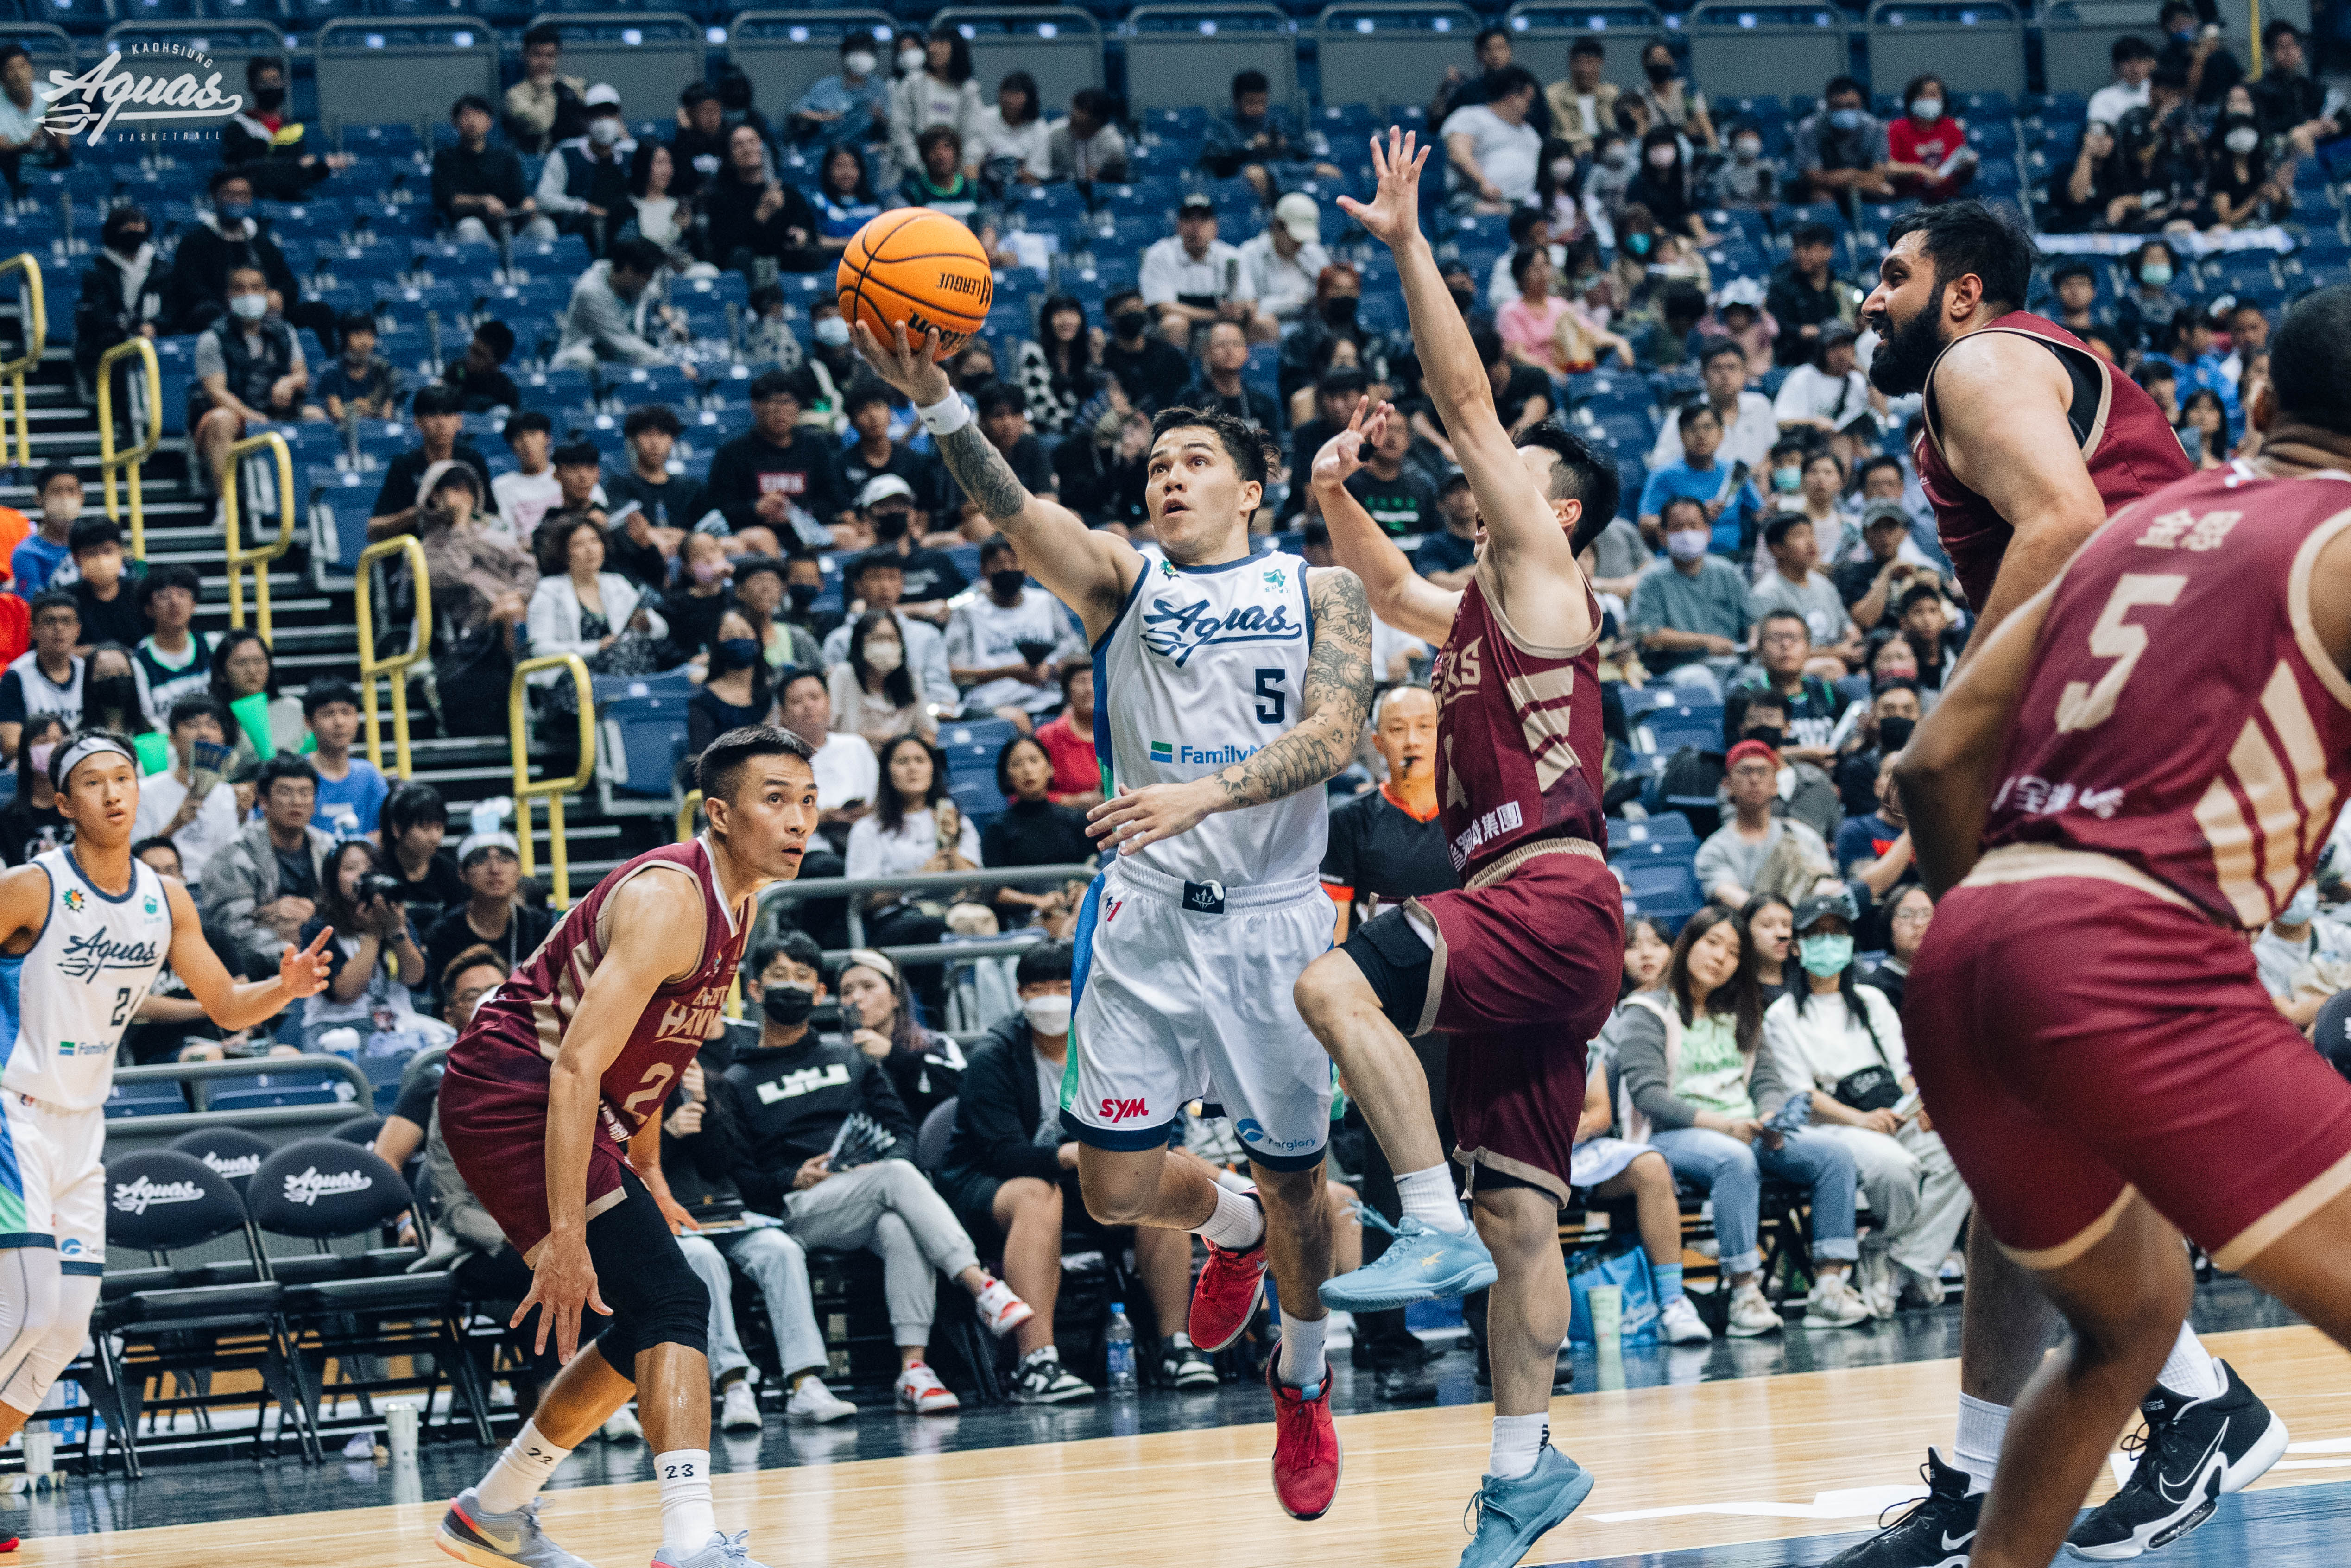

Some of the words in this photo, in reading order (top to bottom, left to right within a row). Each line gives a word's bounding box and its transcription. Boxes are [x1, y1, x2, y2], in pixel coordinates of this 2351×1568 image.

[1140, 598, 1302, 668] Aquas
[2054, 574, 2189, 734] 5
[1252, 666, 1288, 725] 5
[57, 925, 160, 984] Aquas
[1098, 1097, 1149, 1123] SYM
[664, 1463, 695, 1479] 23
